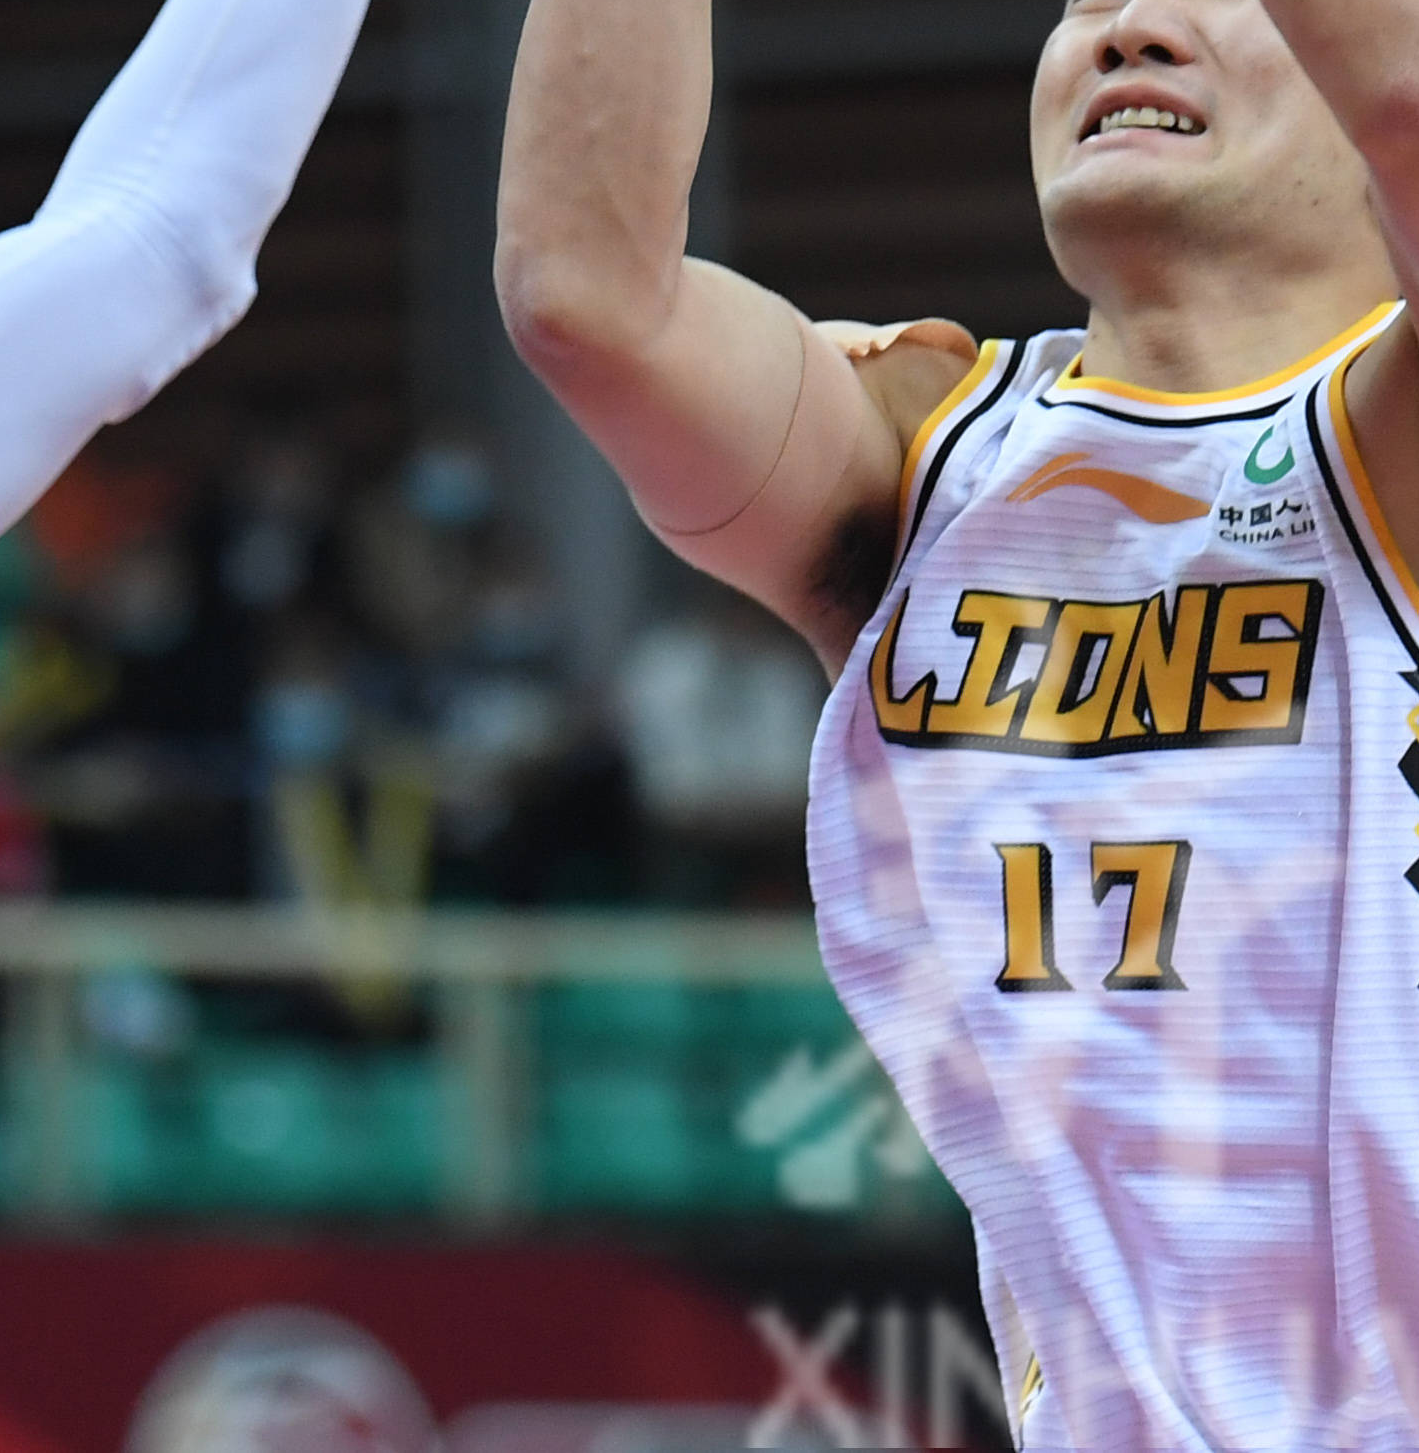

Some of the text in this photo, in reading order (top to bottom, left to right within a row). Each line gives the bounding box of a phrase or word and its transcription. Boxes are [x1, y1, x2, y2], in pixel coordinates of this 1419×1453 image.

[1219, 498, 1311, 527] 中国人
[1219, 527, 1284, 544] CHINA
[869, 579, 1324, 758] LIONS
[993, 840, 1192, 993] 17
